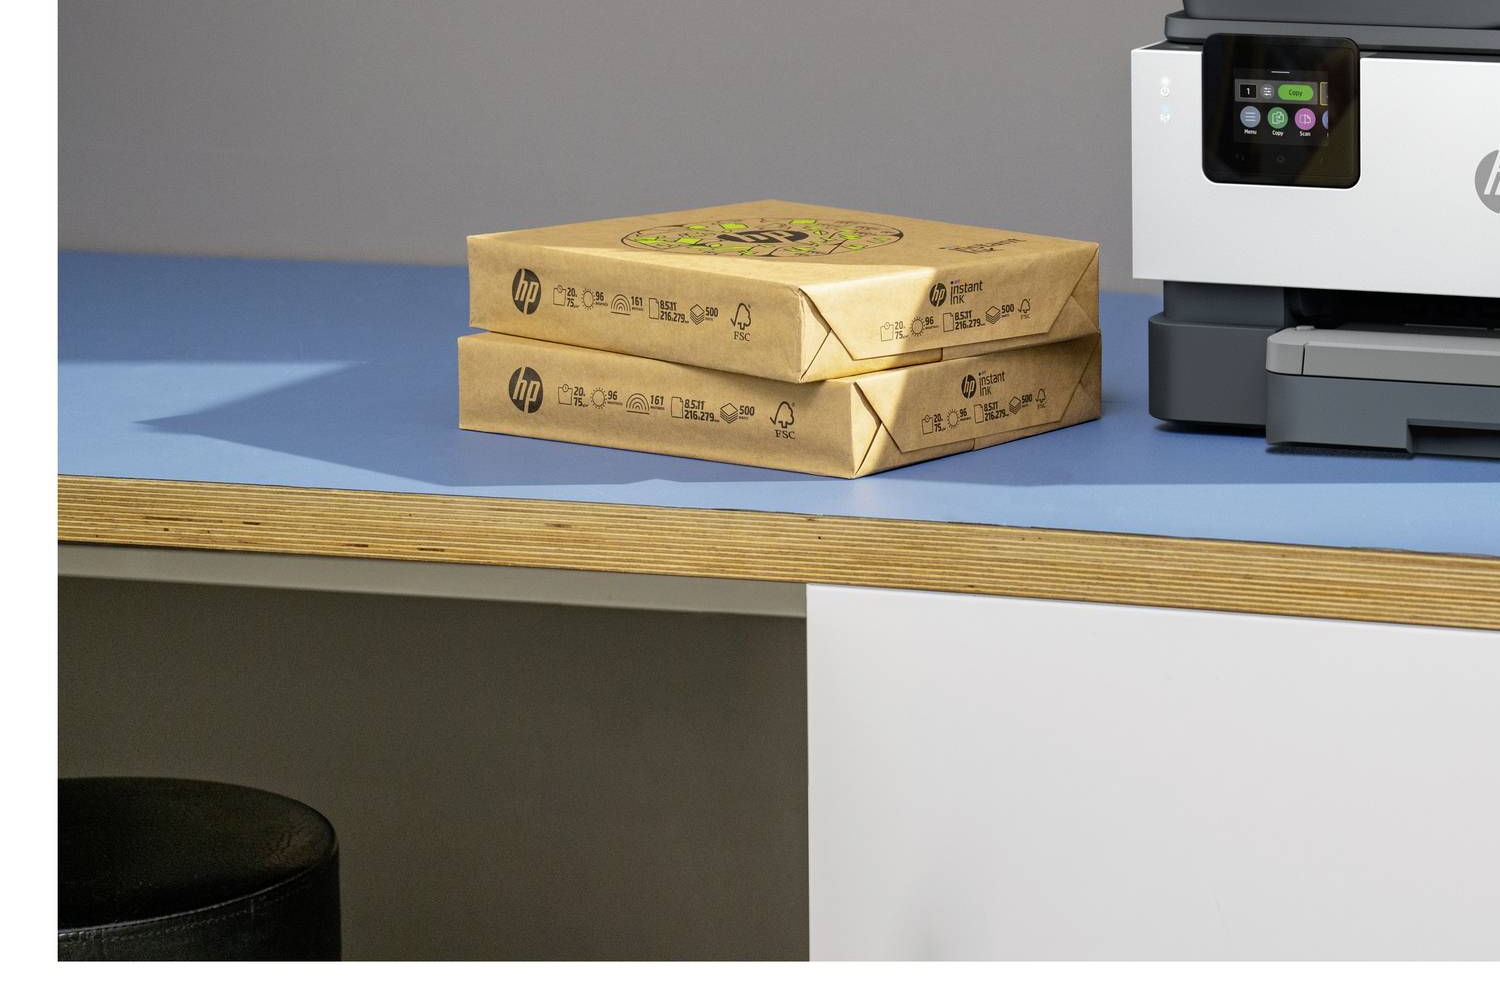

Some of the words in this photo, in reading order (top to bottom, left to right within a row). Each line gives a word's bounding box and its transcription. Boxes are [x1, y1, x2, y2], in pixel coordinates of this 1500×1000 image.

[1246, 87, 1251, 96] 1
[1288, 86, 1303, 97] Copy
[513, 268, 540, 315] hp
[595, 291, 605, 302] 96
[932, 283, 946, 308] hp
[631, 296, 643, 307] 161
[705, 306, 719, 318] 500
[1001, 303, 1015, 314] 500
[924, 316, 935, 326] 96
[733, 331, 751, 342] FSC
[512, 366, 541, 413] hp
[963, 374, 976, 399] hp
[607, 390, 618, 401] 96
[650, 395, 665, 406] 161
[739, 405, 755, 417] 500
[775, 429, 796, 440] FSC
